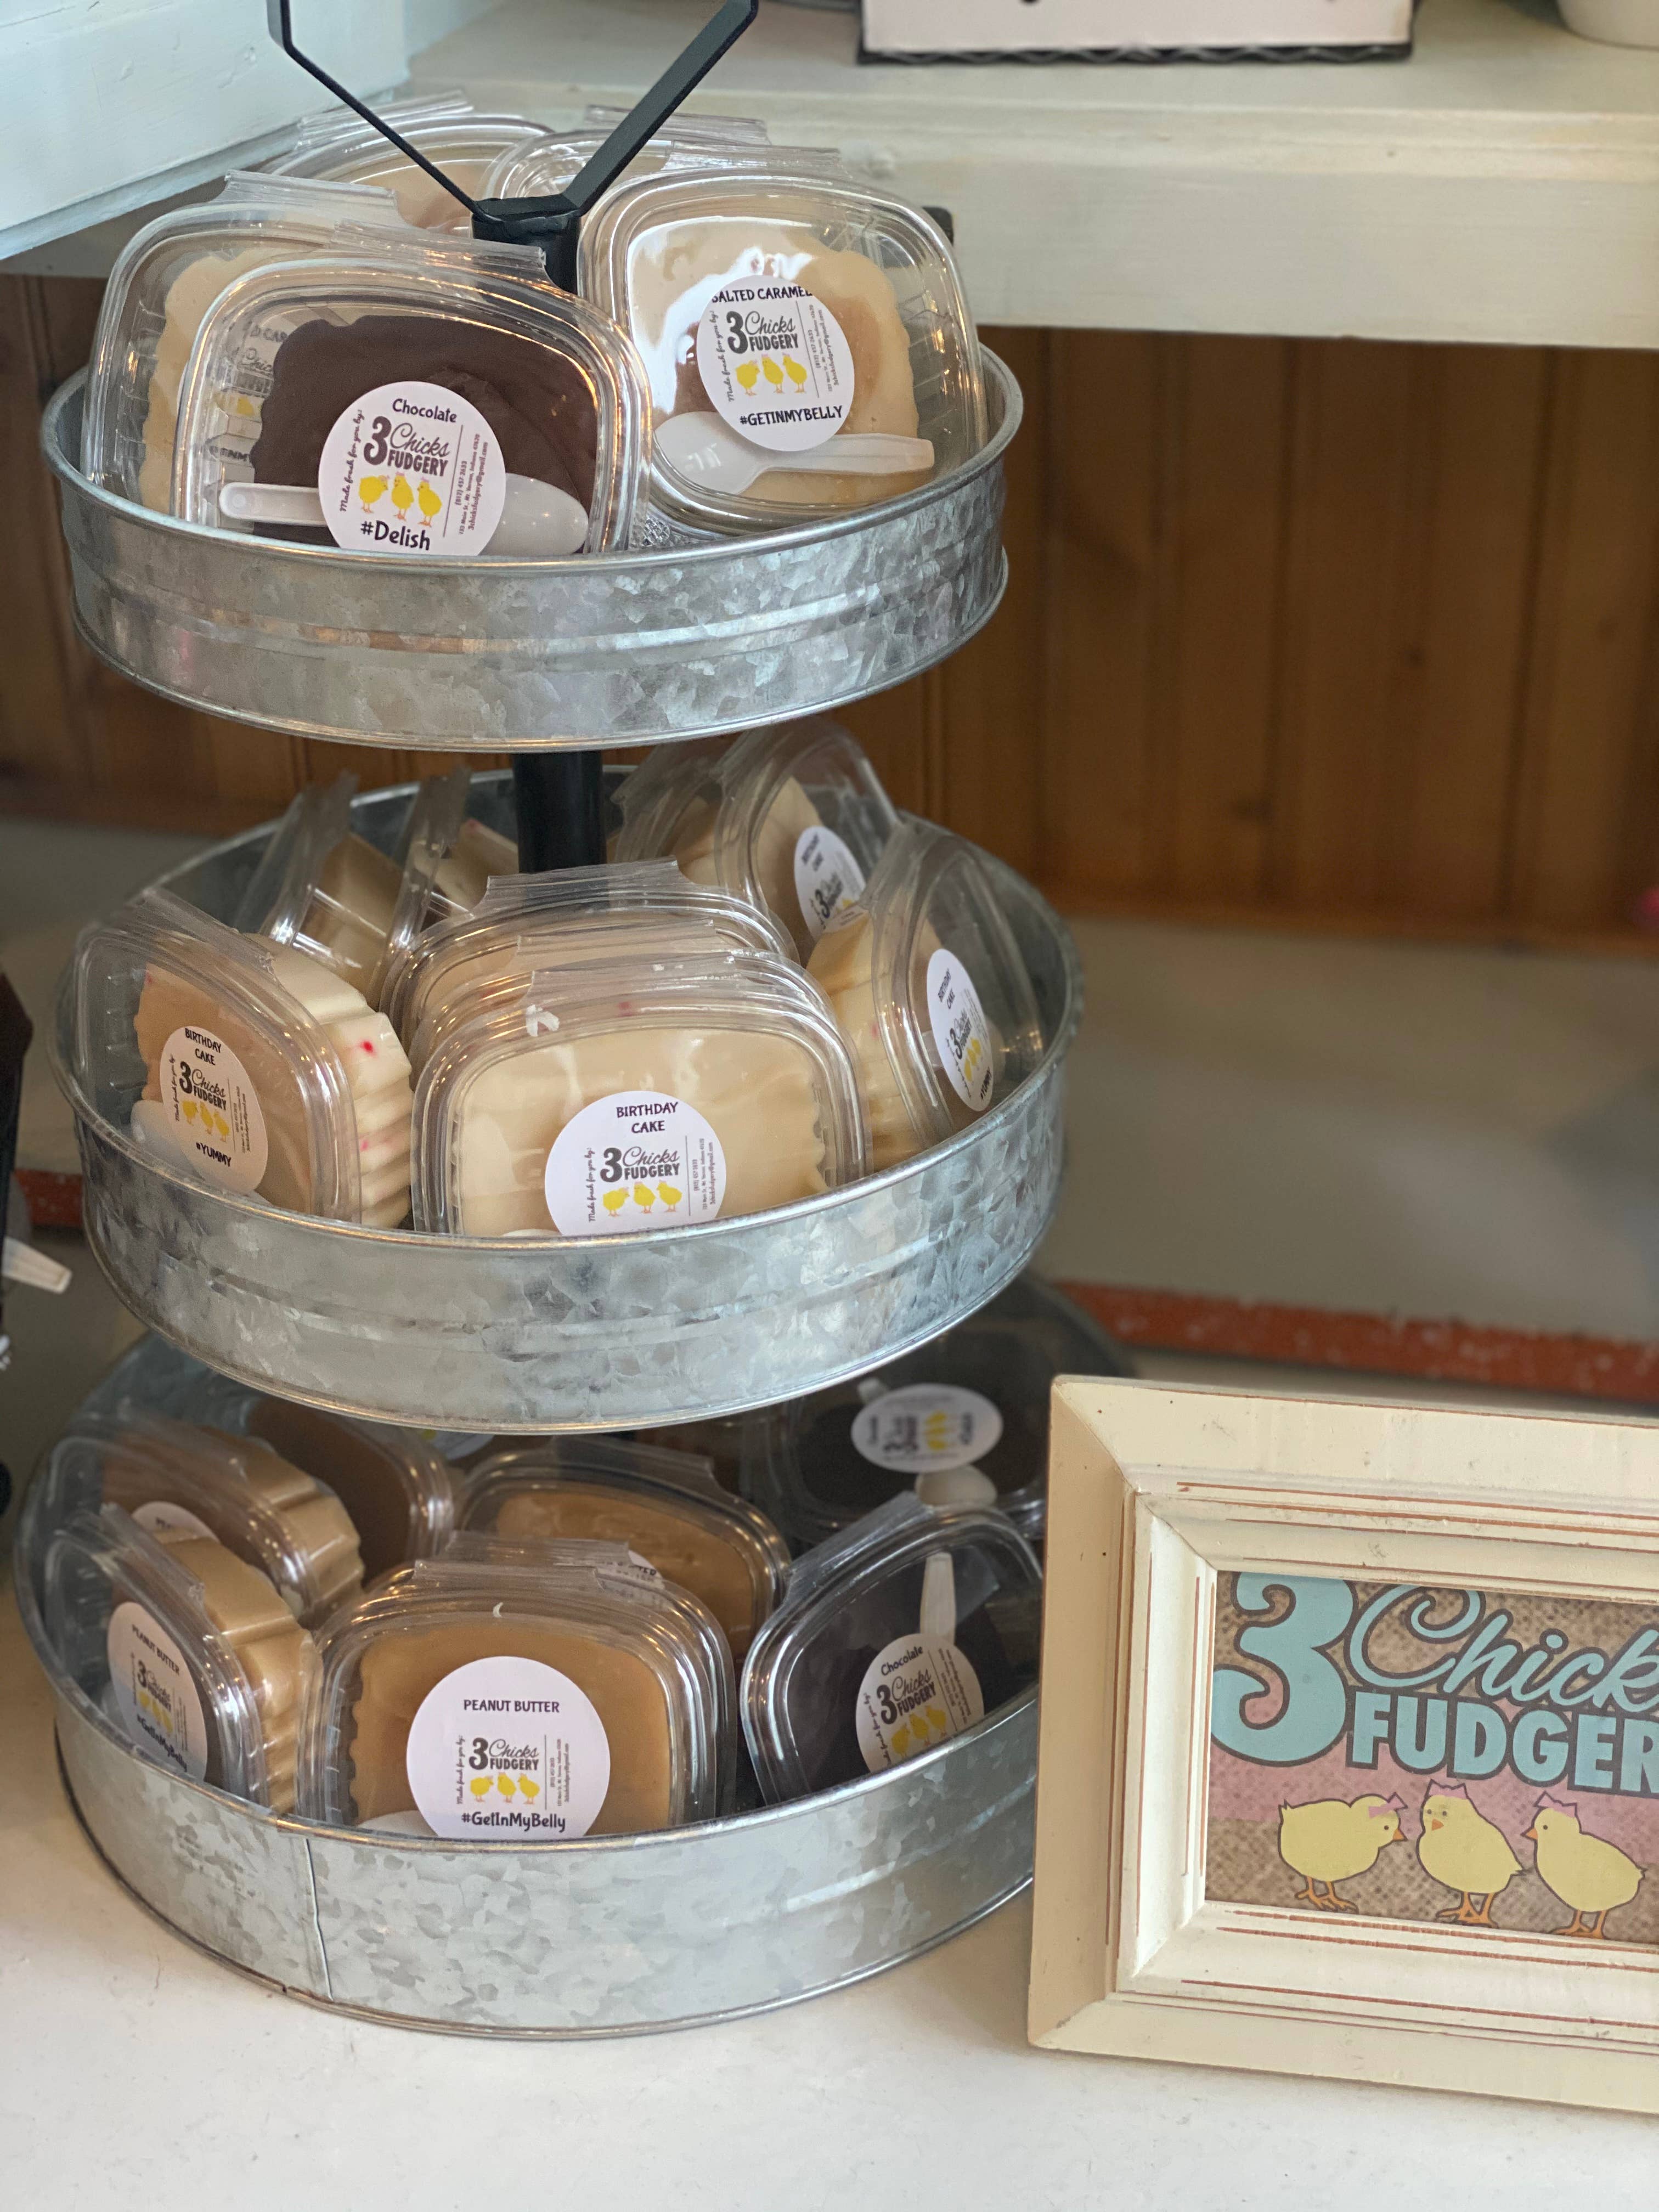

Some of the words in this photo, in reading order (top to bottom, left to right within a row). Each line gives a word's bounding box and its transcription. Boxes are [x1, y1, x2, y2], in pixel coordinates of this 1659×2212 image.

[726, 311, 748, 354] 3
[745, 311, 795, 335] Chicks
[748, 334, 799, 352] FUDGERY
[392, 398, 457, 423] Chocolate
[740, 405, 843, 426] #GETINMYBELLY
[347, 442, 357, 458] for
[364, 416, 392, 465] 3
[390, 422, 450, 457] Chicks
[344, 459, 354, 483] fresh
[388, 449, 448, 476] FUDGERY
[340, 484, 350, 512] Made
[360, 521, 430, 550] #Delish
[185, 1028, 221, 1053] BIRTHDAY
[950, 1028, 962, 1059] 3
[195, 1048, 216, 1066] CAKE
[179, 1061, 193, 1094] 3
[191, 1069, 225, 1098] Chicks
[194, 1085, 226, 1111] FUDGERY
[616, 1102, 679, 1118] BIRTHDAY
[631, 1120, 665, 1133] CAKE
[196, 1142, 232, 1167] #YUMMY
[600, 1148, 622, 1182] 3
[622, 1146, 680, 1166] Chicks
[624, 1163, 680, 1180] FUDGERY
[157, 1647, 179, 1675] BUTTER
[881, 1646, 923, 1675] Chocolate
[1210, 1571, 1357, 1768] 3
[138, 1660, 147, 1688] 3
[464, 1699, 511, 1712] PEANUT
[515, 1701, 560, 1713] BUTTER
[877, 1684, 898, 1724] 3
[891, 1668, 932, 1701] Chicks
[897, 1681, 936, 1716] FUDGERY
[469, 1737, 488, 1770] 3
[489, 1739, 539, 1758] Chicks
[490, 1758, 539, 1771] FUDGERY
[461, 1811, 566, 1833] #GetInMyBelly
